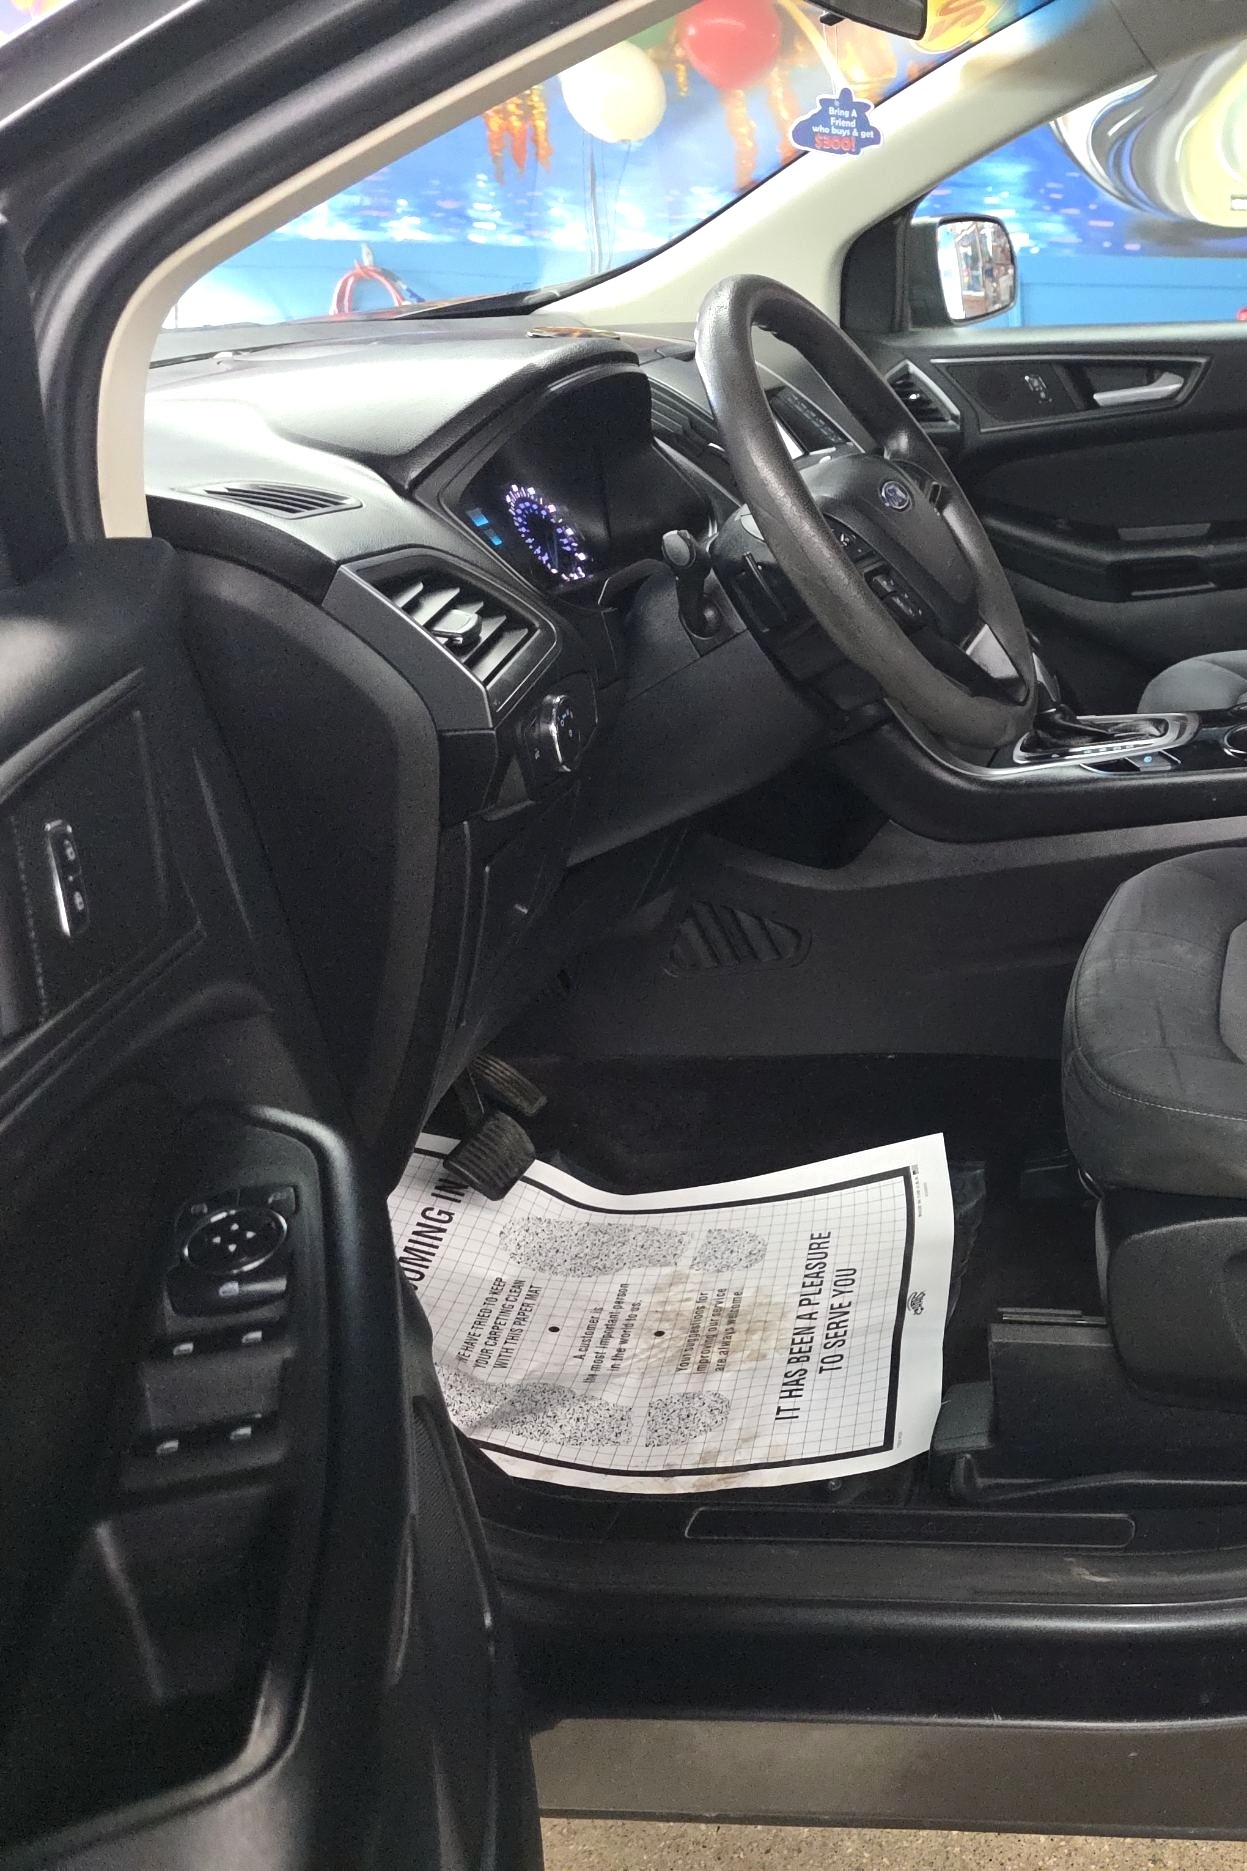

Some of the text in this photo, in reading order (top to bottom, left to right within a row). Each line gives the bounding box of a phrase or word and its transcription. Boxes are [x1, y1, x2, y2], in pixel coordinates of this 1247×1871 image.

[829, 106, 858, 118] Bring A
[830, 117, 856, 127] Friend
[812, 125, 875, 139] who buys & get
[399, 1178, 469, 1291] OMING IN
[489, 1276, 506, 1295] KEEP
[613, 1283, 631, 1310] person
[483, 1296, 498, 1306] TO
[471, 1308, 492, 1331] TRIED
[472, 1279, 526, 1368] YOUR CARPETING CLEAN
[493, 1284, 543, 1369] WITH THIS PAPER MAT
[625, 1313, 638, 1321] to
[775, 1231, 832, 1421] IT HAS BEEN A PLEASURE
[818, 1267, 857, 1375] TO SERVE YOU
[578, 1315, 599, 1352] customer
[595, 1311, 621, 1349] important
[619, 1323, 634, 1346] world
[675, 1292, 709, 1372] Your suggestions for
[693, 1288, 728, 1375] improving our service
[718, 1326, 736, 1356] always
[460, 1331, 482, 1353] HAVE
[590, 1351, 607, 1372] most
[611, 1348, 626, 1361] the
[715, 1358, 727, 1372] are
